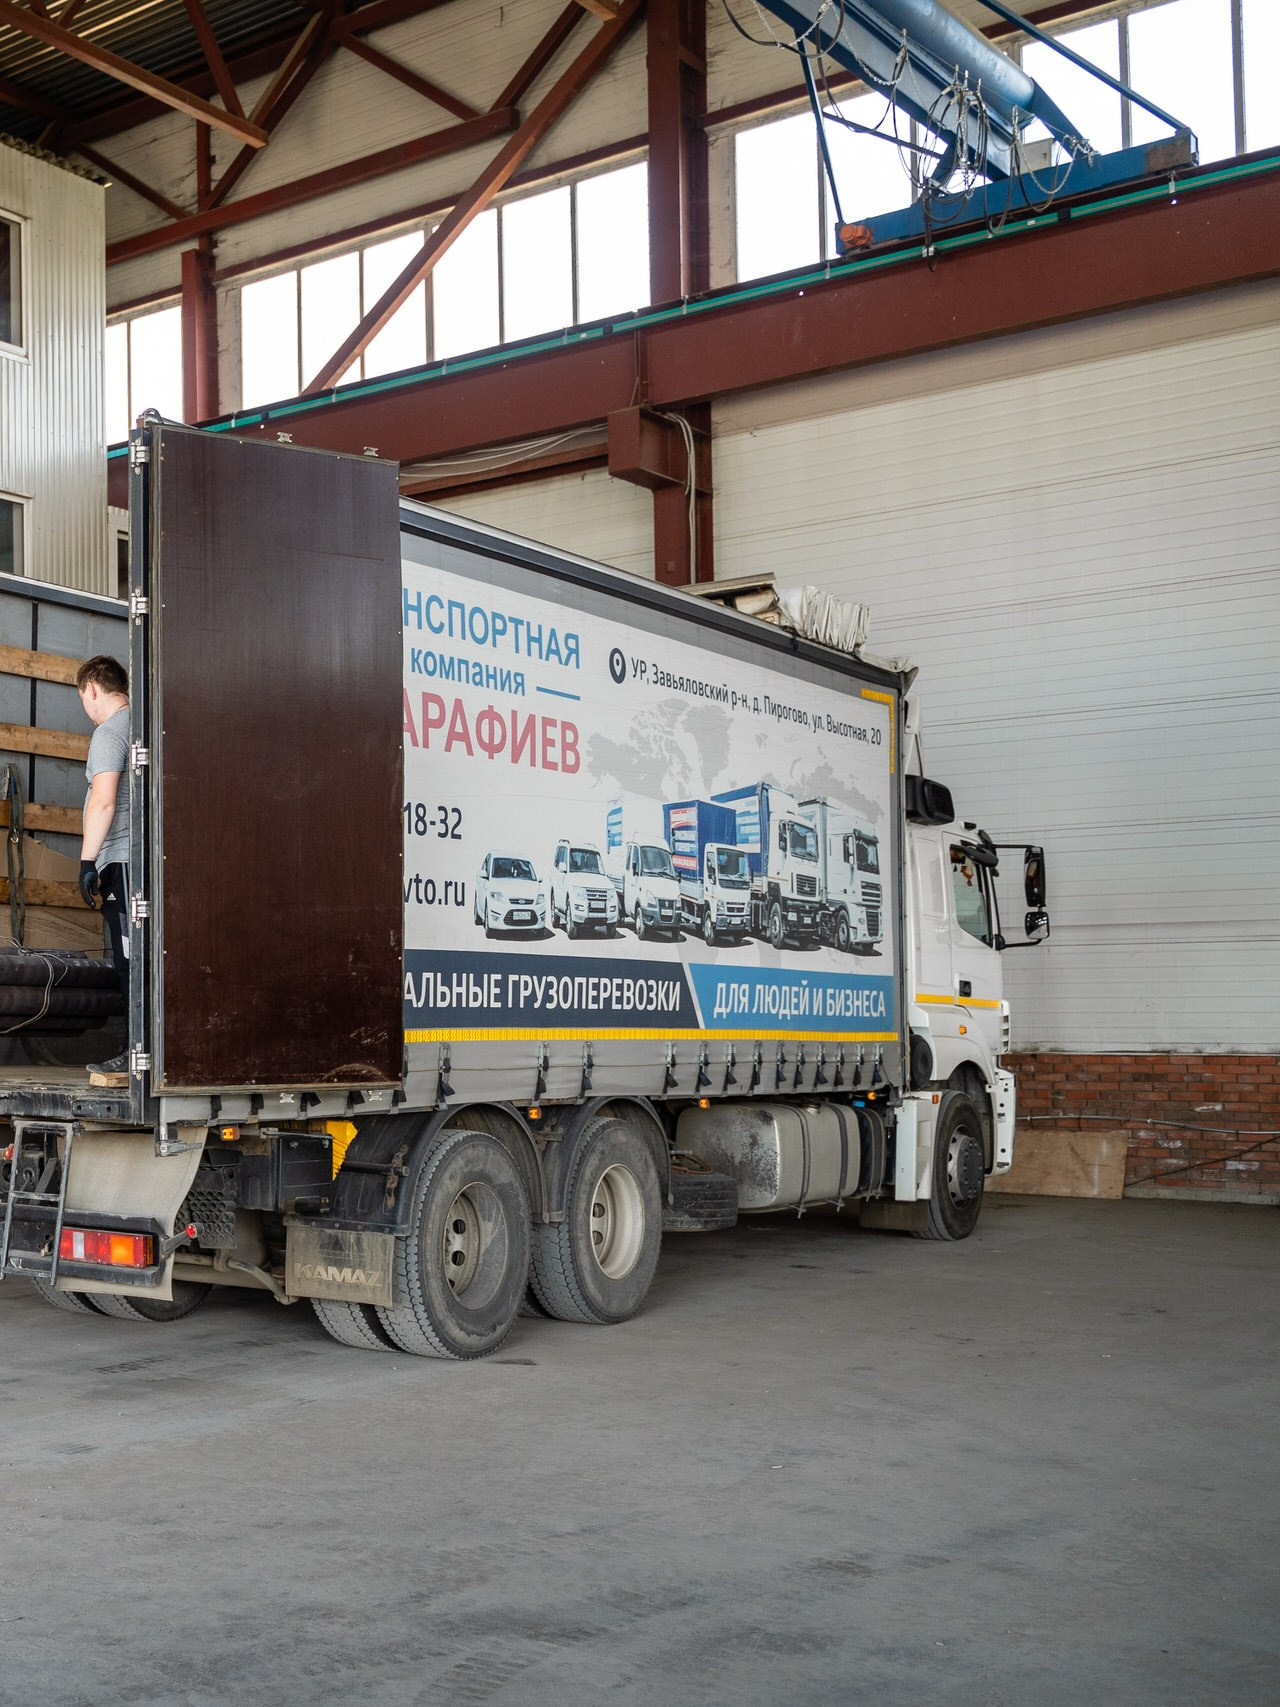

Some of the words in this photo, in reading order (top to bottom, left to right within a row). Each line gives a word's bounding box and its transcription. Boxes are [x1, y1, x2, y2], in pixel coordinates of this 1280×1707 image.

[403, 587, 580, 669] НСПОРТНАЯ
[411, 647, 525, 696] компания
[631, 657, 650, 684] УР,
[652, 664, 729, 704] Завьяловский
[731, 690, 751, 713] р-н,
[753, 698, 762, 714] д.
[764, 696, 811, 728] Пирогово,
[812, 714, 825, 734] ул.
[827, 714, 869, 742] Высотная,
[871, 728, 881, 745] 20
[404, 802, 462, 840] 18-32
[404, 971, 502, 1008] АЛЬНЫЕ
[508, 973, 681, 1011] ГРУЗОПЕРЕВОЗКИ
[713, 982, 749, 1019] ДЛЯ
[752, 979, 809, 1020] ЛЮДЕЙ
[813, 987, 822, 1016] И
[826, 988, 886, 1017] БИЗНЕСА
[294, 1263, 383, 1287] KAMAZ
